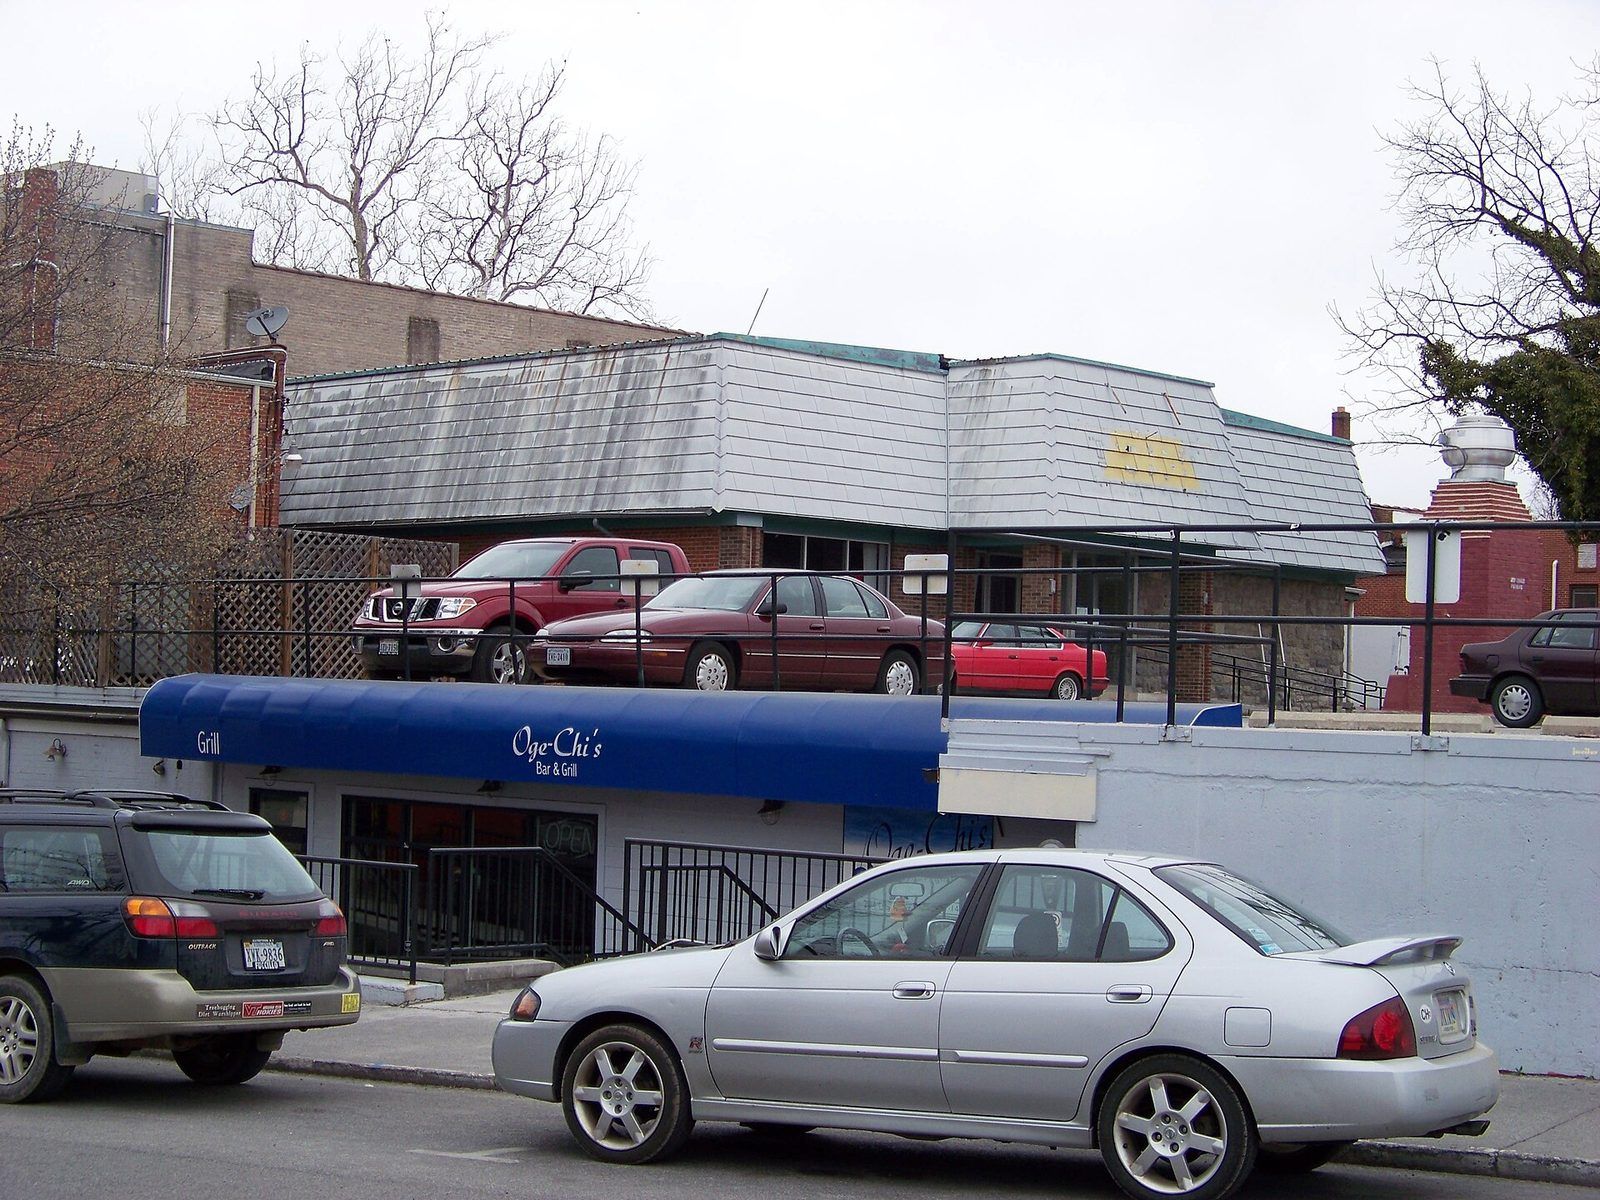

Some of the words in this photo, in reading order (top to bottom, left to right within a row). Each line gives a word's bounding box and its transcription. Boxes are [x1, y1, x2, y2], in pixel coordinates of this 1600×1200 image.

[197, 730, 220, 755] Grill
[512, 725, 602, 763] Oge-Chi's
[536, 761, 551, 775] Bar
[553, 762, 560, 776] &
[561, 763, 578, 777] Grill
